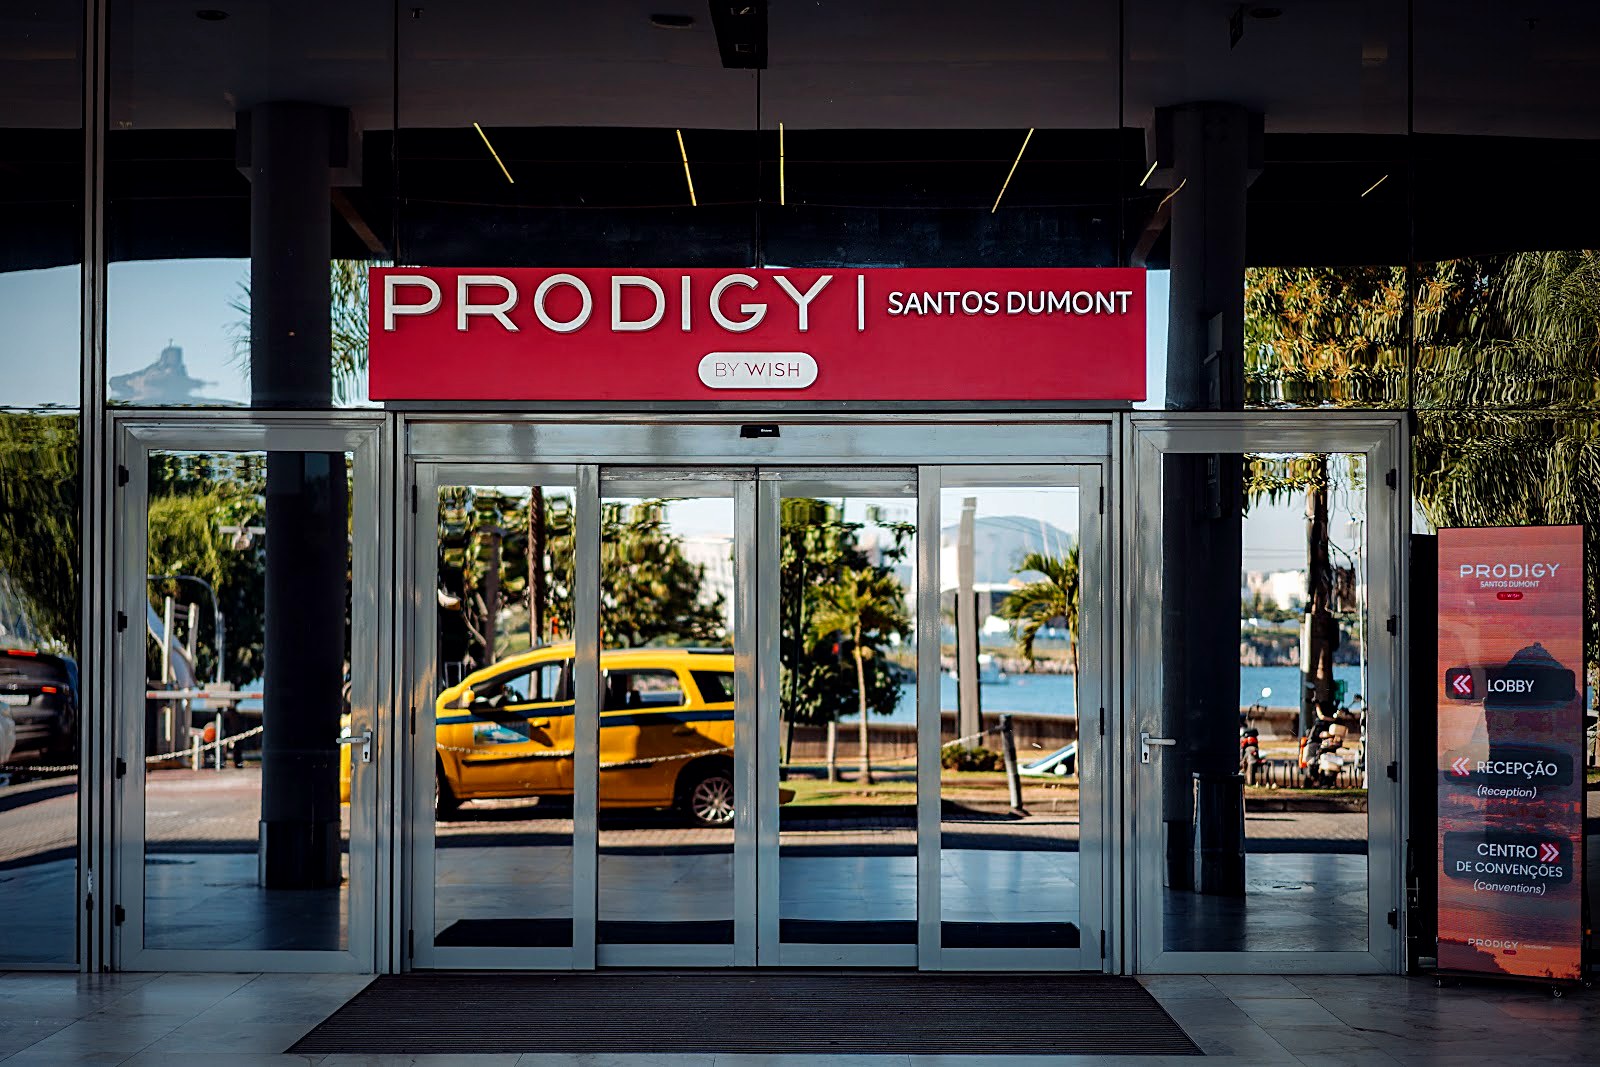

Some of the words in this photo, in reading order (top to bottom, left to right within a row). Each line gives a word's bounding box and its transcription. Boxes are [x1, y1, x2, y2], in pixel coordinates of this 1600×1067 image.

[384, 273, 834, 333] PRODIGY
[887, 290, 1001, 316] SANTOS
[1006, 290, 1133, 316] DUMONT
[715, 362, 740, 377] BY
[744, 362, 800, 377] WISH
[1460, 563, 1560, 578] PRODIGY
[1480, 580, 1508, 588] SANTOS
[1508, 580, 1540, 588] DUMONT
[1487, 679, 1535, 693] LOBBY
[1476, 760, 1558, 779] RECEPÇÃO
[1477, 784, 1537, 799] (Reception)
[1476, 843, 1538, 859] CENTRO
[1456, 860, 1472, 872] DE
[1474, 861, 1563, 879] CONVENÇÕES
[1473, 879, 1546, 895] (Conventions)
[1467, 938, 1519, 949] PRODIGY
